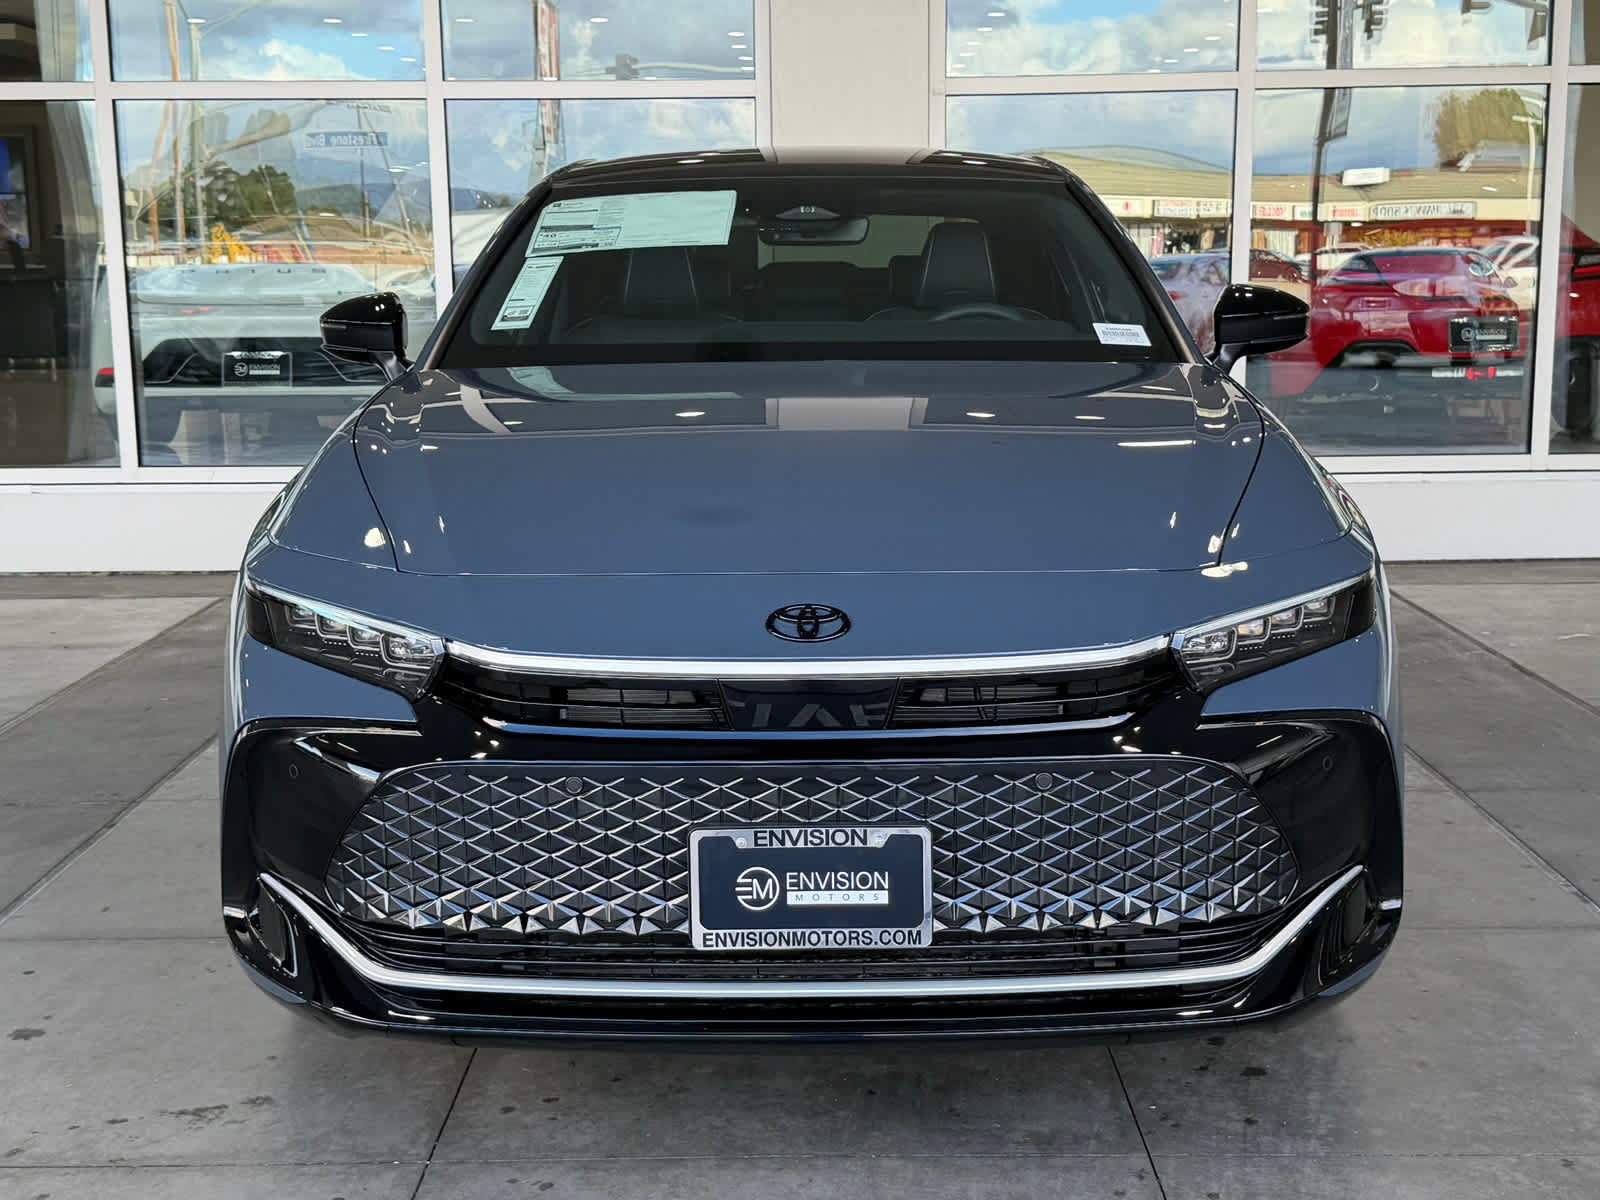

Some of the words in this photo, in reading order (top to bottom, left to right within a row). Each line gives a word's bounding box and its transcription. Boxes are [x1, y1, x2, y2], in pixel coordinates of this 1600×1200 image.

[753, 829, 868, 847] ENVISION
[786, 871, 889, 890] ENVISION
[794, 893, 880, 902] MOTORS
[702, 929, 922, 948] ENVISIONMOTORS.COM
